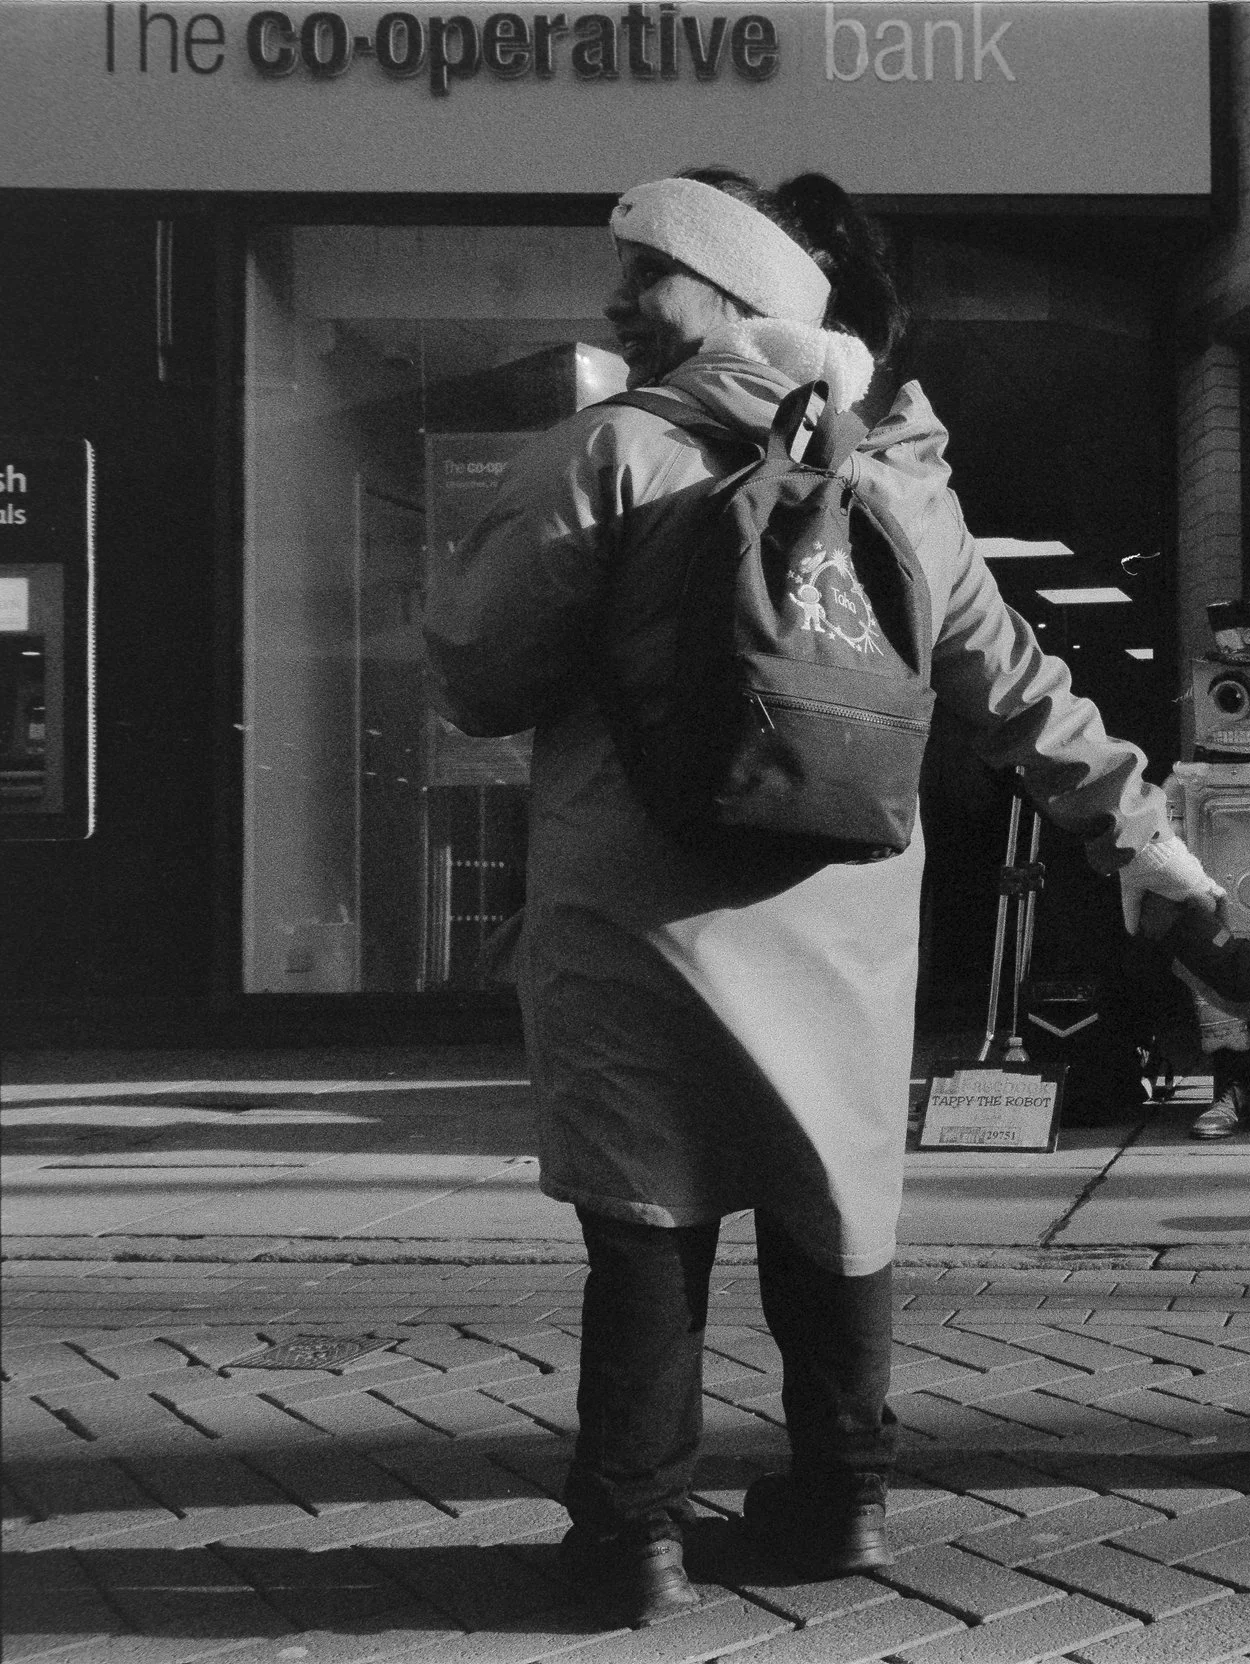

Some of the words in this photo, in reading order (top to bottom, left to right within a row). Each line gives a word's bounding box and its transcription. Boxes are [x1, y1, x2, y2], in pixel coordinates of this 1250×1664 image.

[106, 3, 226, 75] The
[824, 3, 1017, 82] bank
[931, 1095, 974, 1109] TAPPY
[977, 1095, 1002, 1107] THE
[1005, 1096, 1052, 1109] ROBOT
[986, 1130, 1016, 1141] 29751
